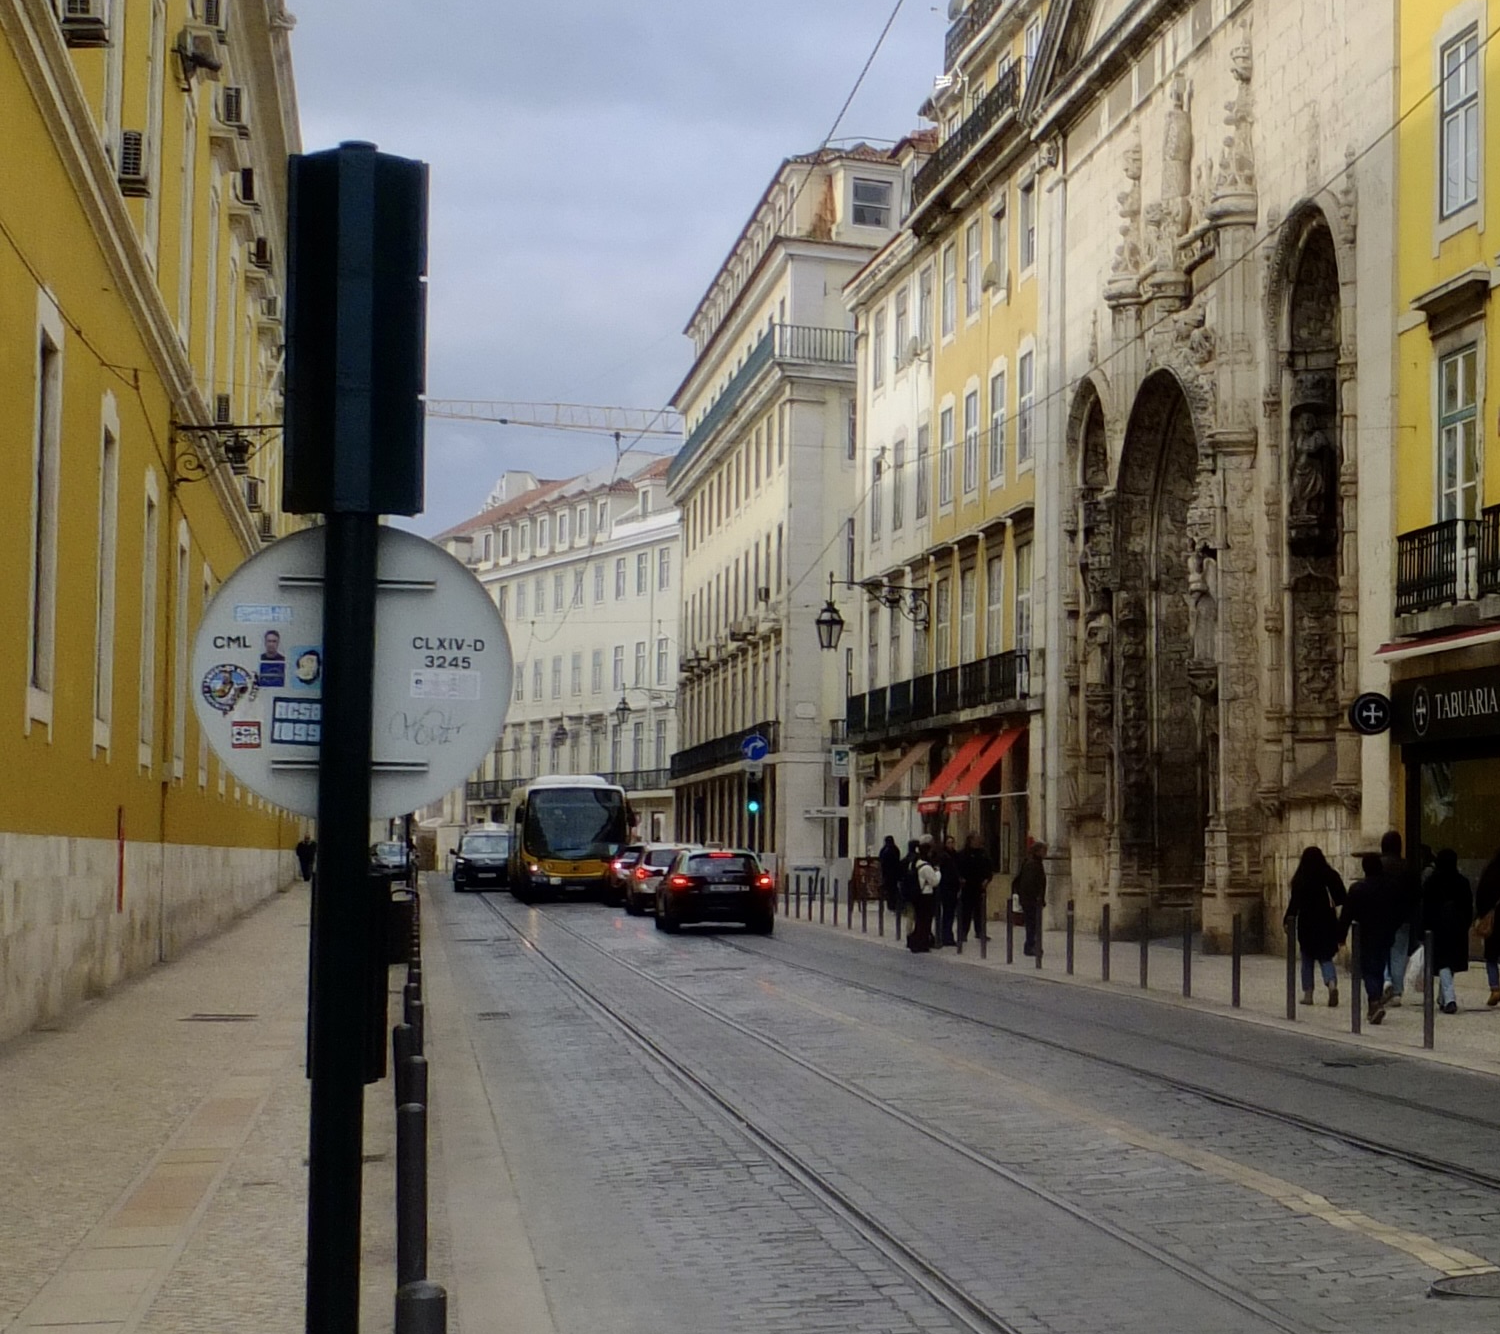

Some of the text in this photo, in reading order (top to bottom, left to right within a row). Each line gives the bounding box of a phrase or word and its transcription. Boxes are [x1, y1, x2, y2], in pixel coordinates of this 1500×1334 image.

[213, 636, 252, 649] CML
[412, 636, 486, 652] CLXIV-D
[424, 655, 472, 670] 3245
[1434, 686, 1498, 720] TABUARIA
